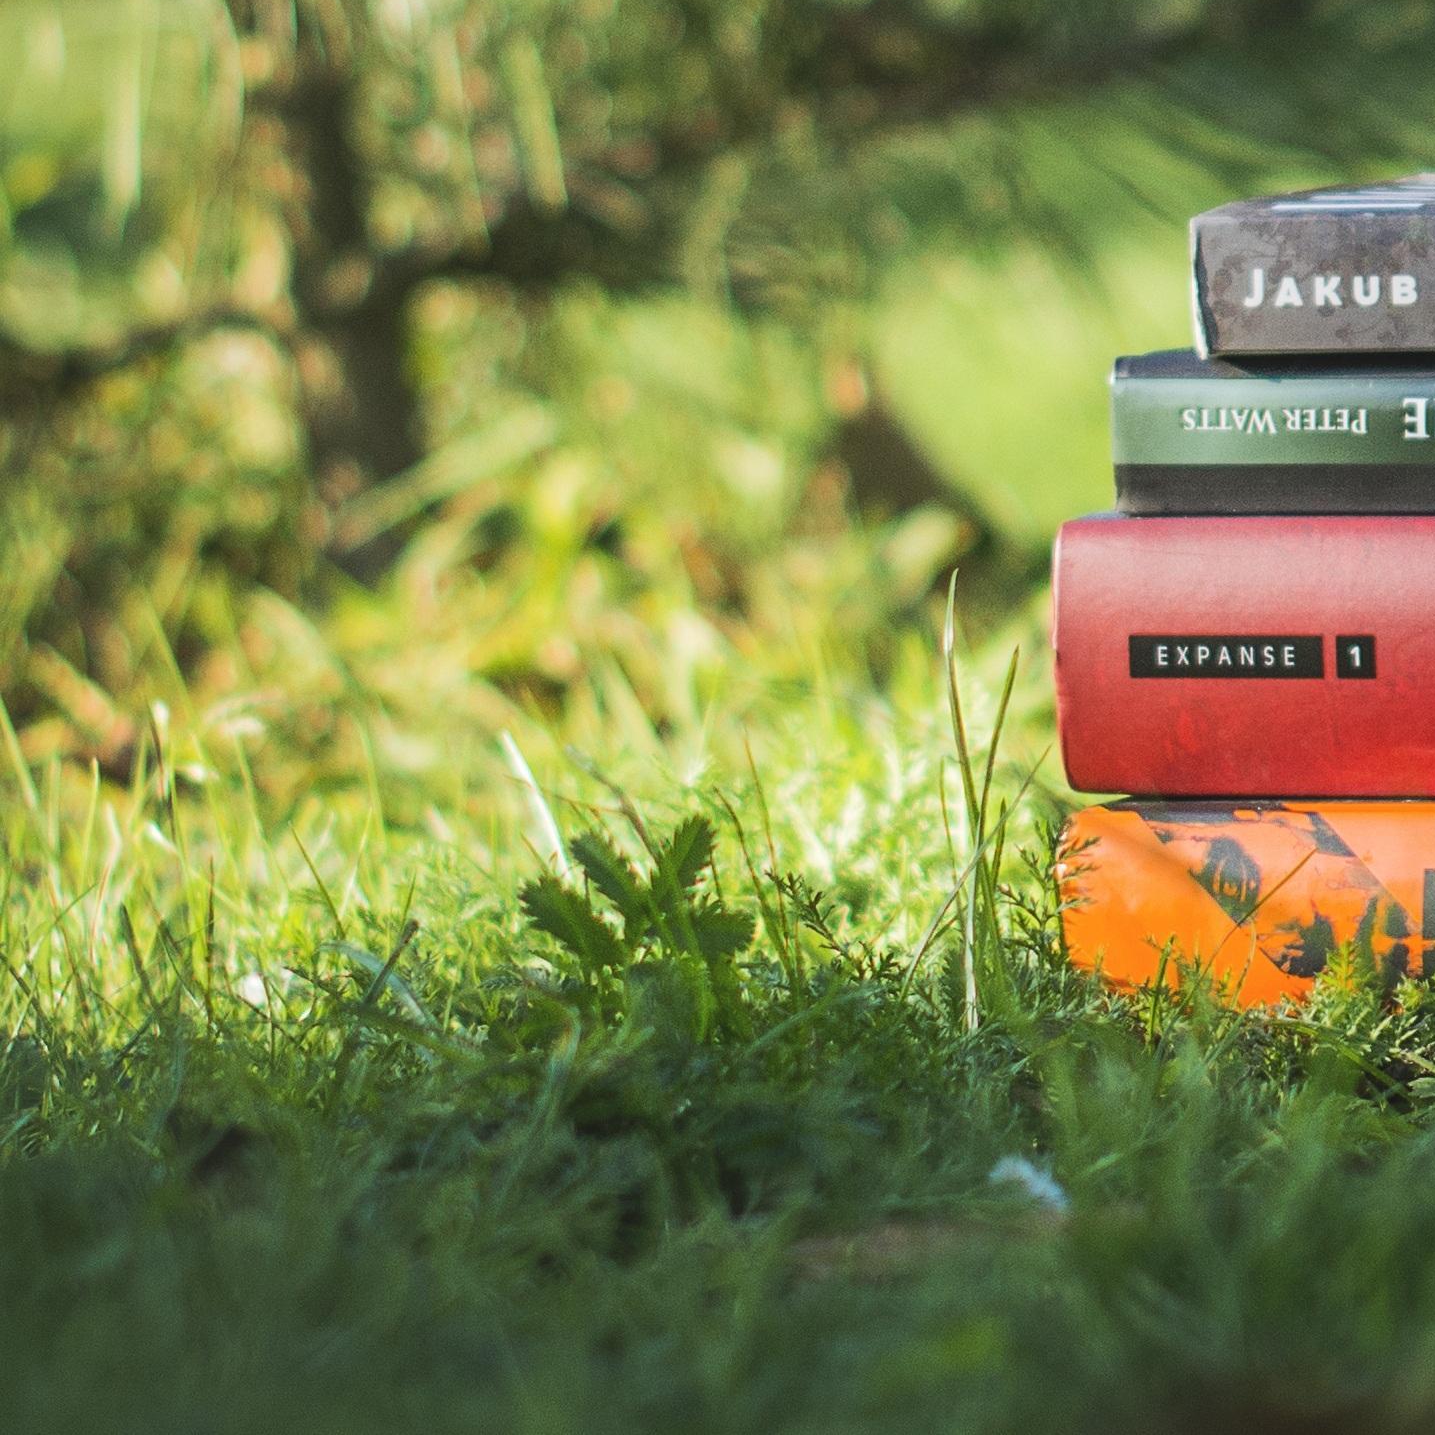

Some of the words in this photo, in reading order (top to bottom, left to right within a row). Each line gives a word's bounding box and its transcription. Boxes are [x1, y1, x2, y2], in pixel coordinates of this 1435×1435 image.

[1242, 266, 1418, 308] JAKUB
[1181, 409, 1279, 435] WATTS
[1283, 409, 1369, 434] PETER
[1156, 645, 1296, 667] EXPANSE
[1349, 645, 1362, 668] 1
